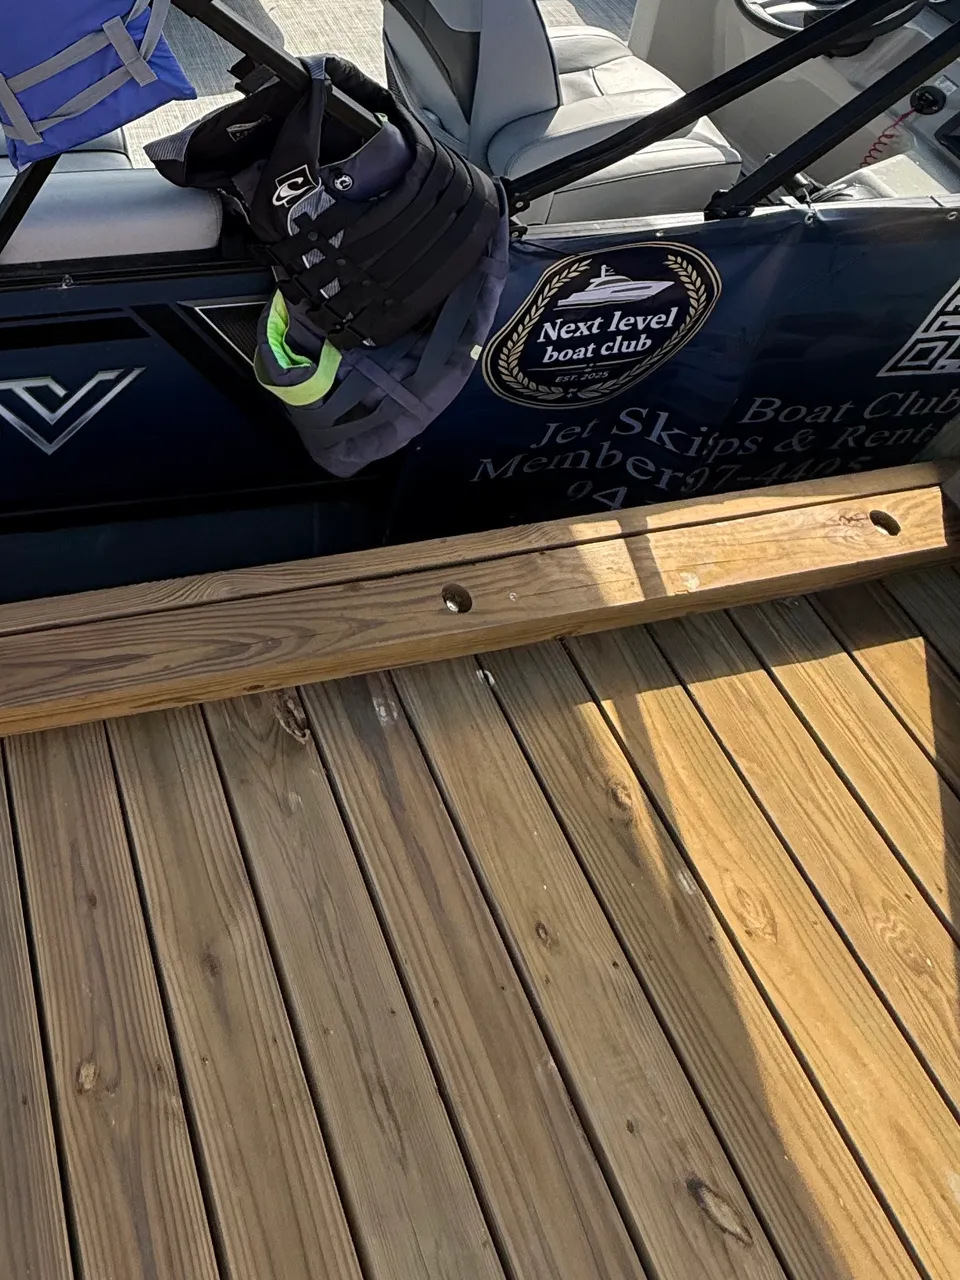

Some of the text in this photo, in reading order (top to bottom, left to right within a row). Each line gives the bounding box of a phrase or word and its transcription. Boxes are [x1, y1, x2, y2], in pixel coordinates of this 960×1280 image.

[536, 307, 679, 343] Next level
[542, 334, 652, 363] boat club
[555, 371, 609, 383] EST. 2025
[529, 417, 600, 450] Jet
[736, 396, 855, 423] Boat
[773, 428, 817, 452] &
[827, 421, 938, 451] Rent
